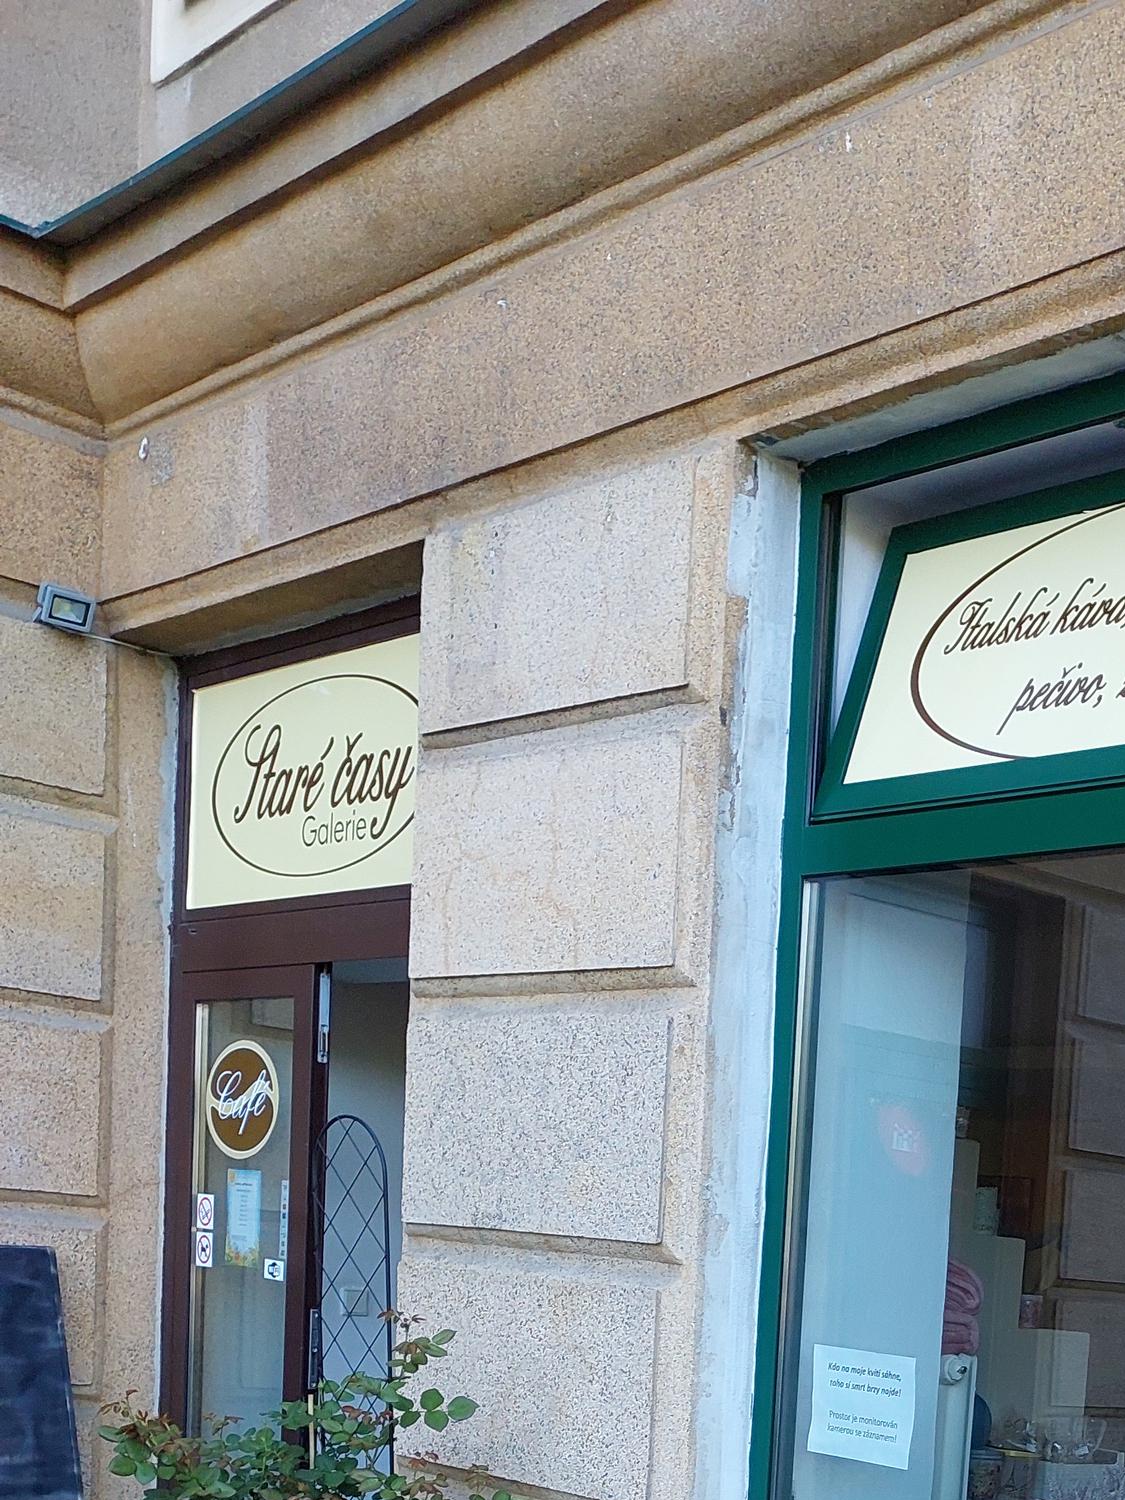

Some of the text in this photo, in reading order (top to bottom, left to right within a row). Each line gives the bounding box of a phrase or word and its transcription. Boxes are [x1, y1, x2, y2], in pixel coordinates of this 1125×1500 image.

[943, 586, 1060, 656] Italská
[995, 661, 1107, 736] pečivo,
[233, 723, 416, 840] Staré časy
[301, 809, 367, 847] Galerie
[828, 1362, 840, 1371] Kdo
[841, 1365, 850, 1373] na
[850, 1366, 867, 1376] moje
[851, 1383, 866, 1392] smrt
[866, 1382, 881, 1396] brzy
[827, 1422, 854, 1435] kamerou
[854, 1428, 862, 1437] se
[829, 1410, 898, 1429] Prostor je monitorován
